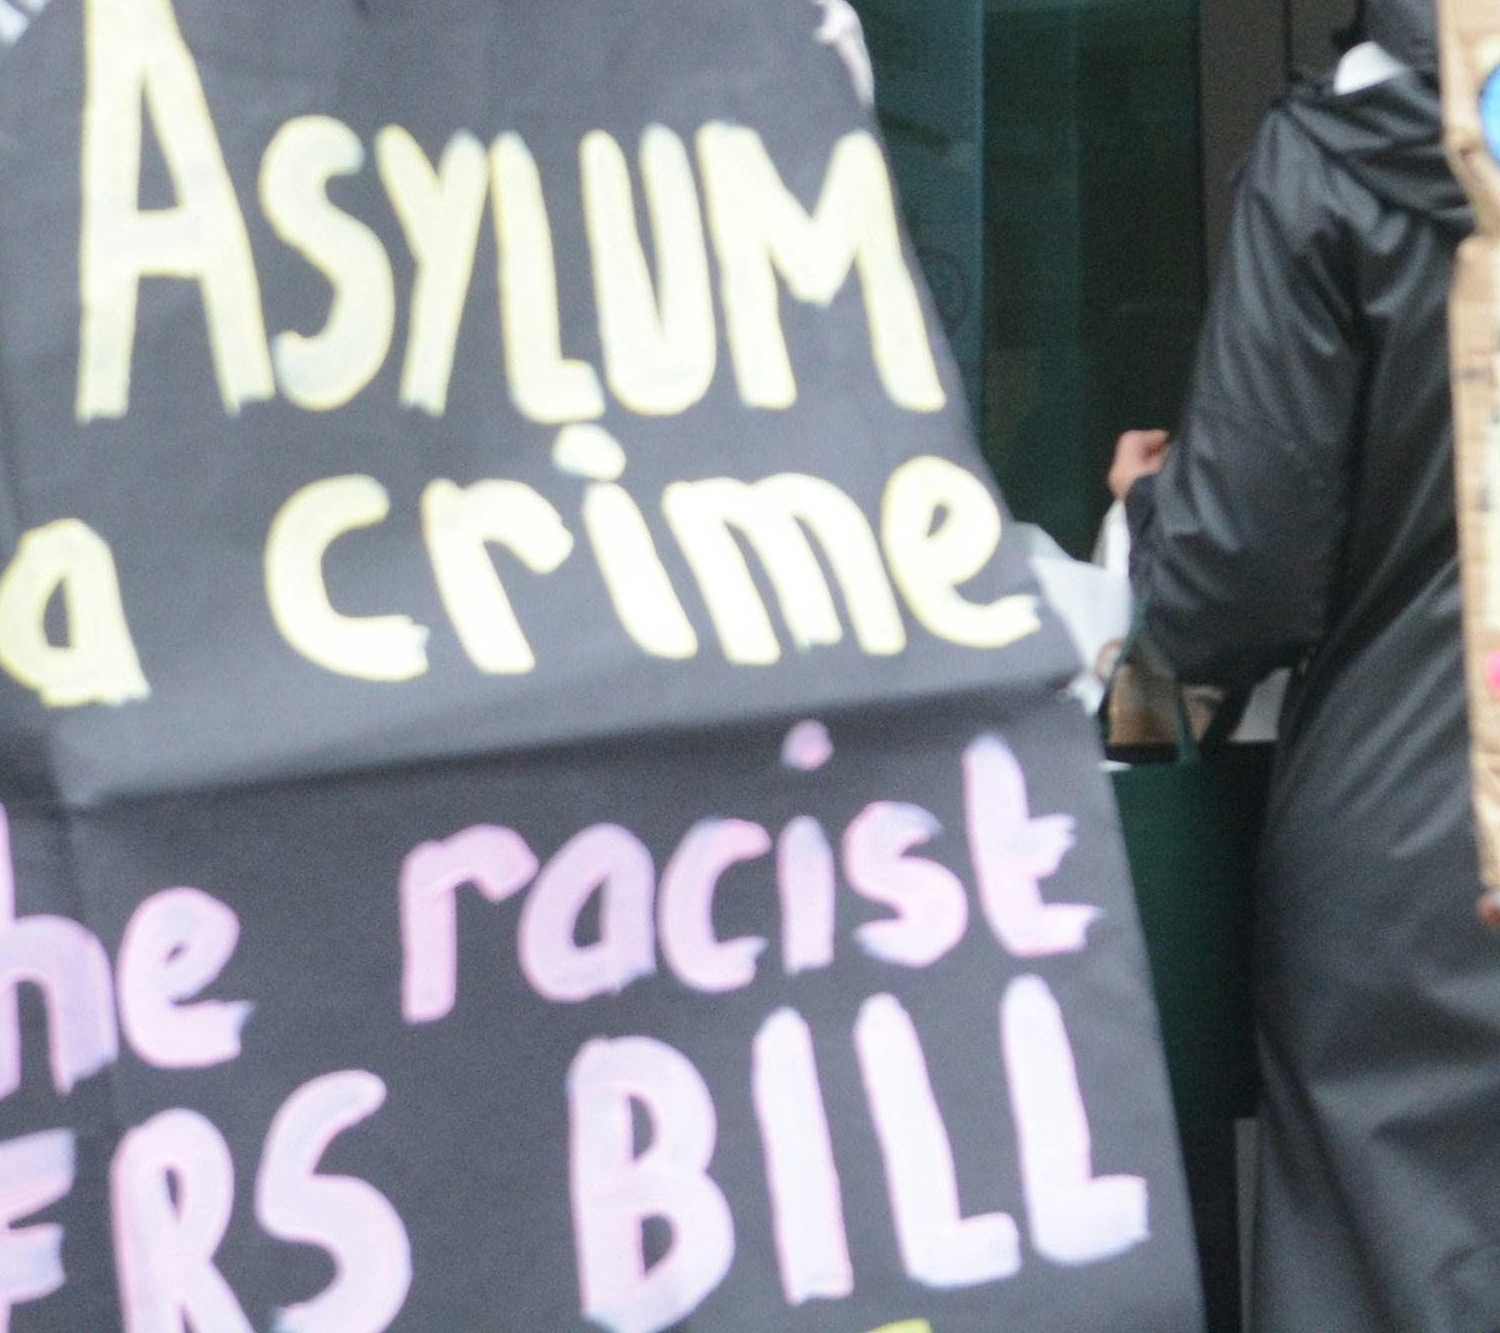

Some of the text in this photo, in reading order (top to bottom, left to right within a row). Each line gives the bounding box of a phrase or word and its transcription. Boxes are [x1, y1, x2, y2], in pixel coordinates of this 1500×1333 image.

[263, 421, 1043, 683] crime
[398, 722, 1102, 1025] racist
[567, 973, 1150, 1333] BILL
